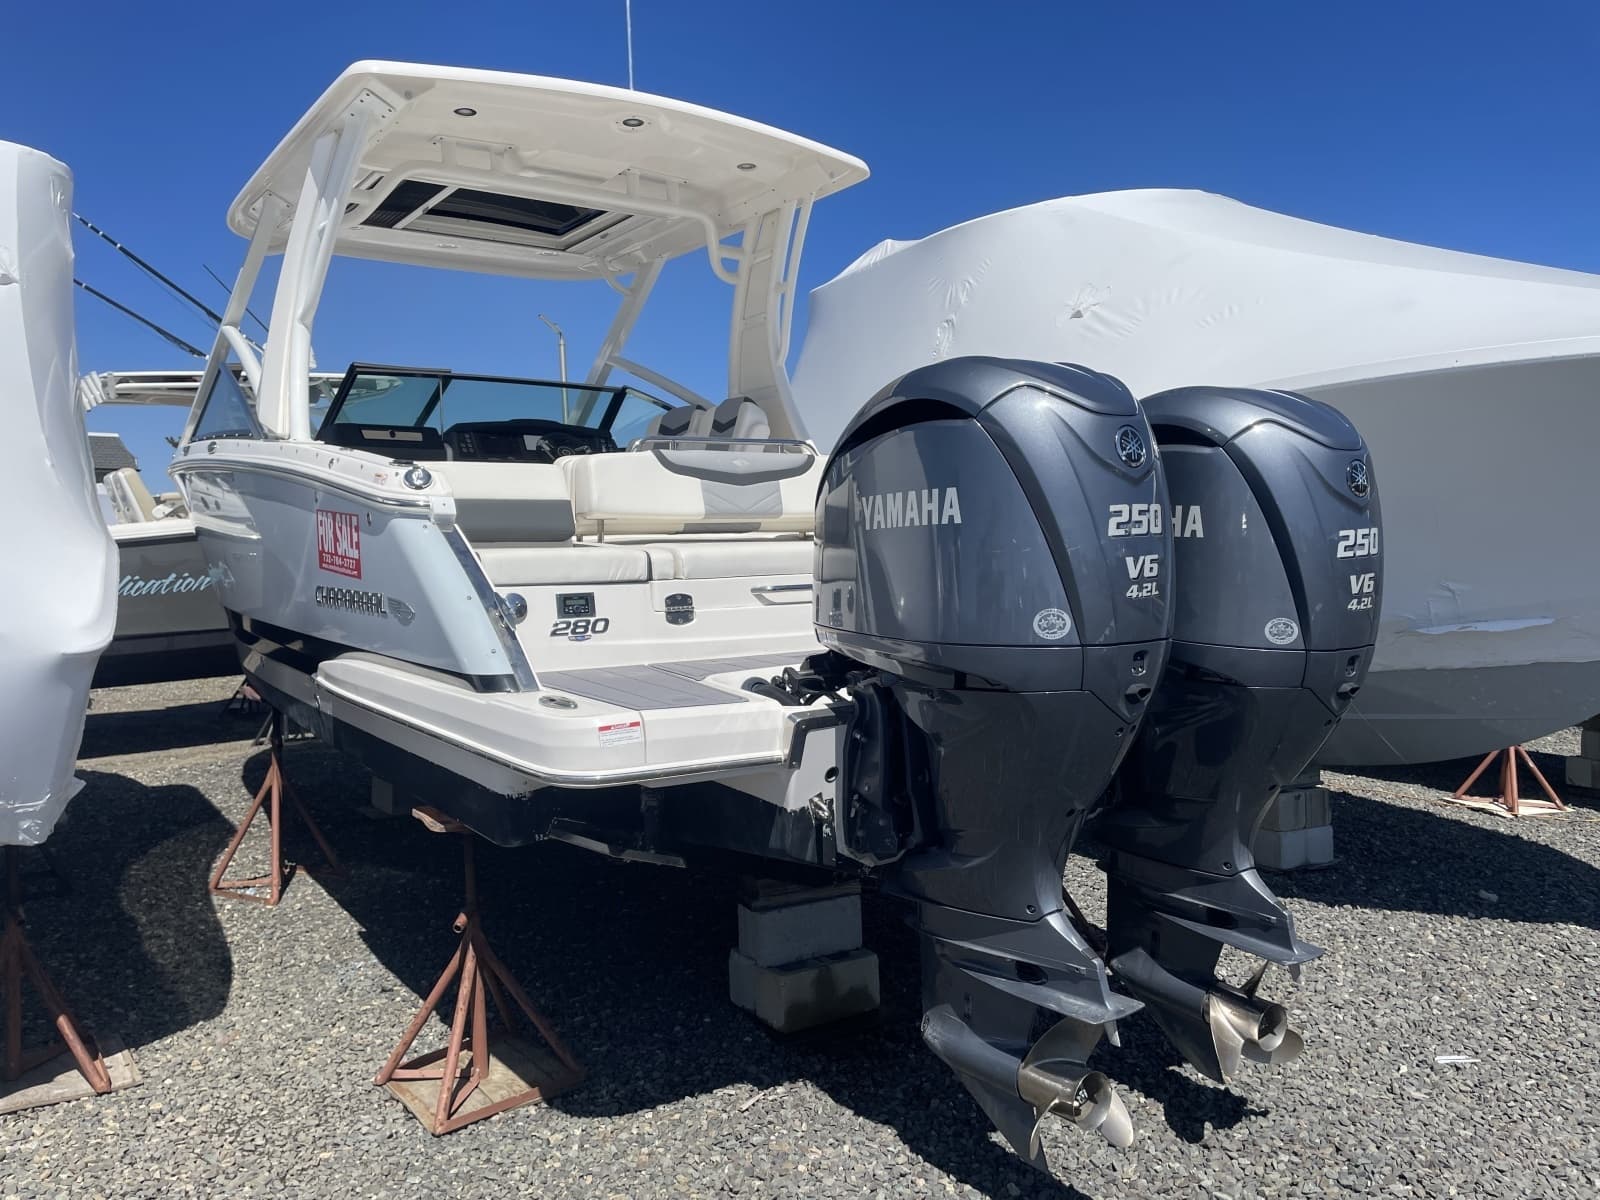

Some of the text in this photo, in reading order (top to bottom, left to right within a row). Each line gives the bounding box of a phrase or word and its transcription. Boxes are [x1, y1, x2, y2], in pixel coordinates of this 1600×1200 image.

[861, 487, 962, 531] YAMAHA
[1108, 503, 1162, 537] 250
[317, 511, 360, 560] FOR SALE
[1337, 527, 1379, 559] 250
[1125, 554, 1159, 579] V6
[1126, 581, 1160, 598] 4.2L
[1350, 572, 1375, 594] V6
[316, 585, 388, 615] CHAPARRAL
[1347, 596, 1373, 611] 4.2L
[550, 615, 610, 637] 280
